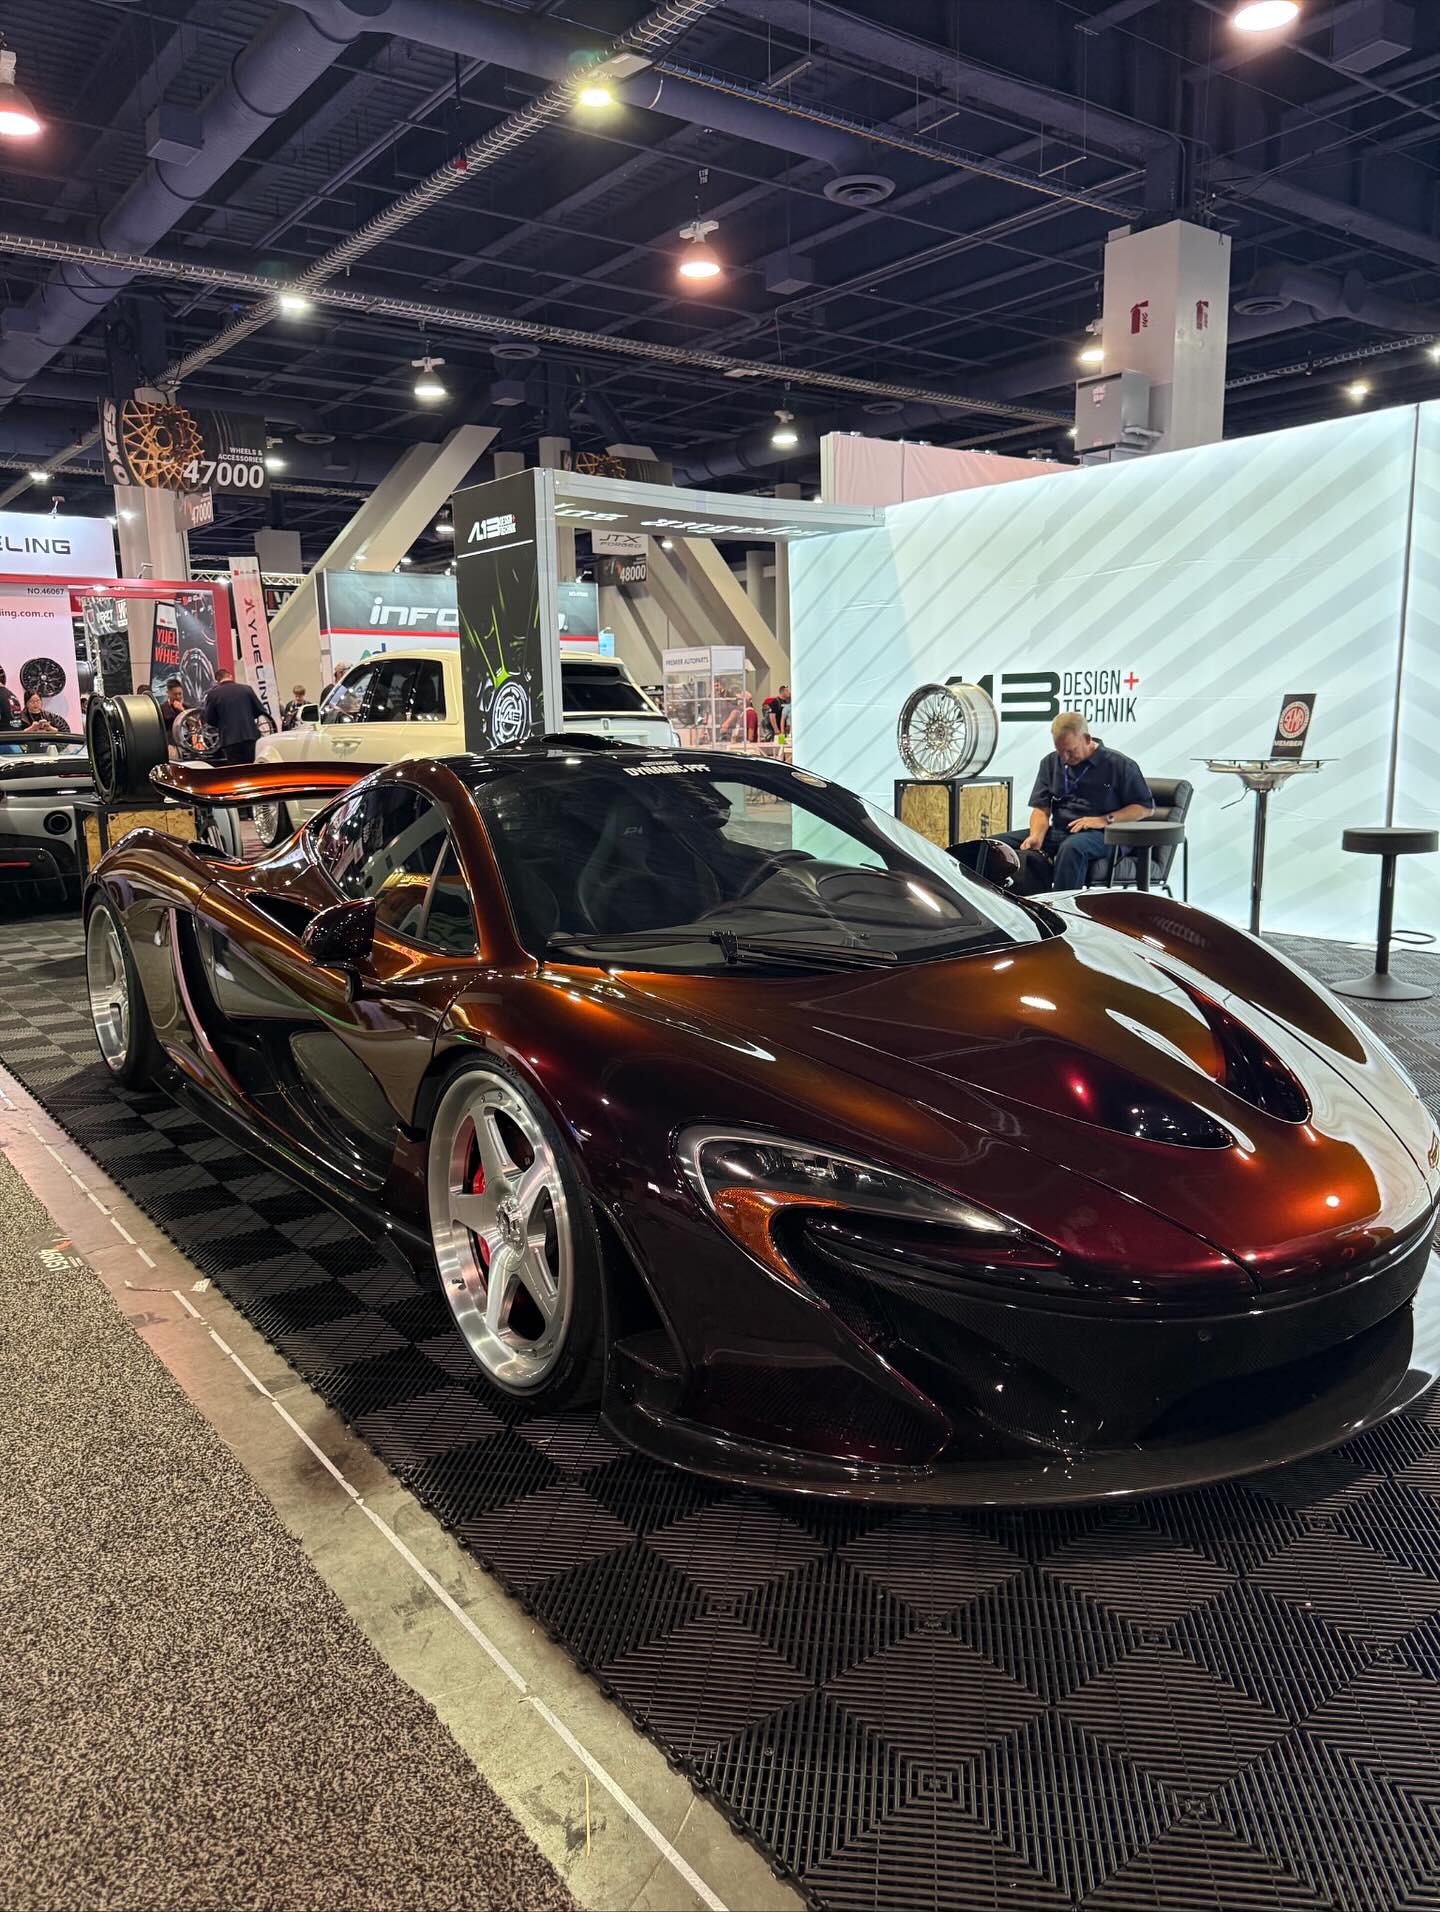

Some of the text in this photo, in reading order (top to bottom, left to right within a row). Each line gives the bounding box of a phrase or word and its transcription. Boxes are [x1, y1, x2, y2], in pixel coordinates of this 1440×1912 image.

[229, 447, 255, 455] WHEELS
[218, 454, 264, 463] ACCESSORIES
[183, 460, 264, 489] 47000
[599, 534, 641, 543] JTX
[0, 535, 71, 555] LING
[620, 565, 646, 583] 48000
[622, 765, 688, 776] DYNAMIC
